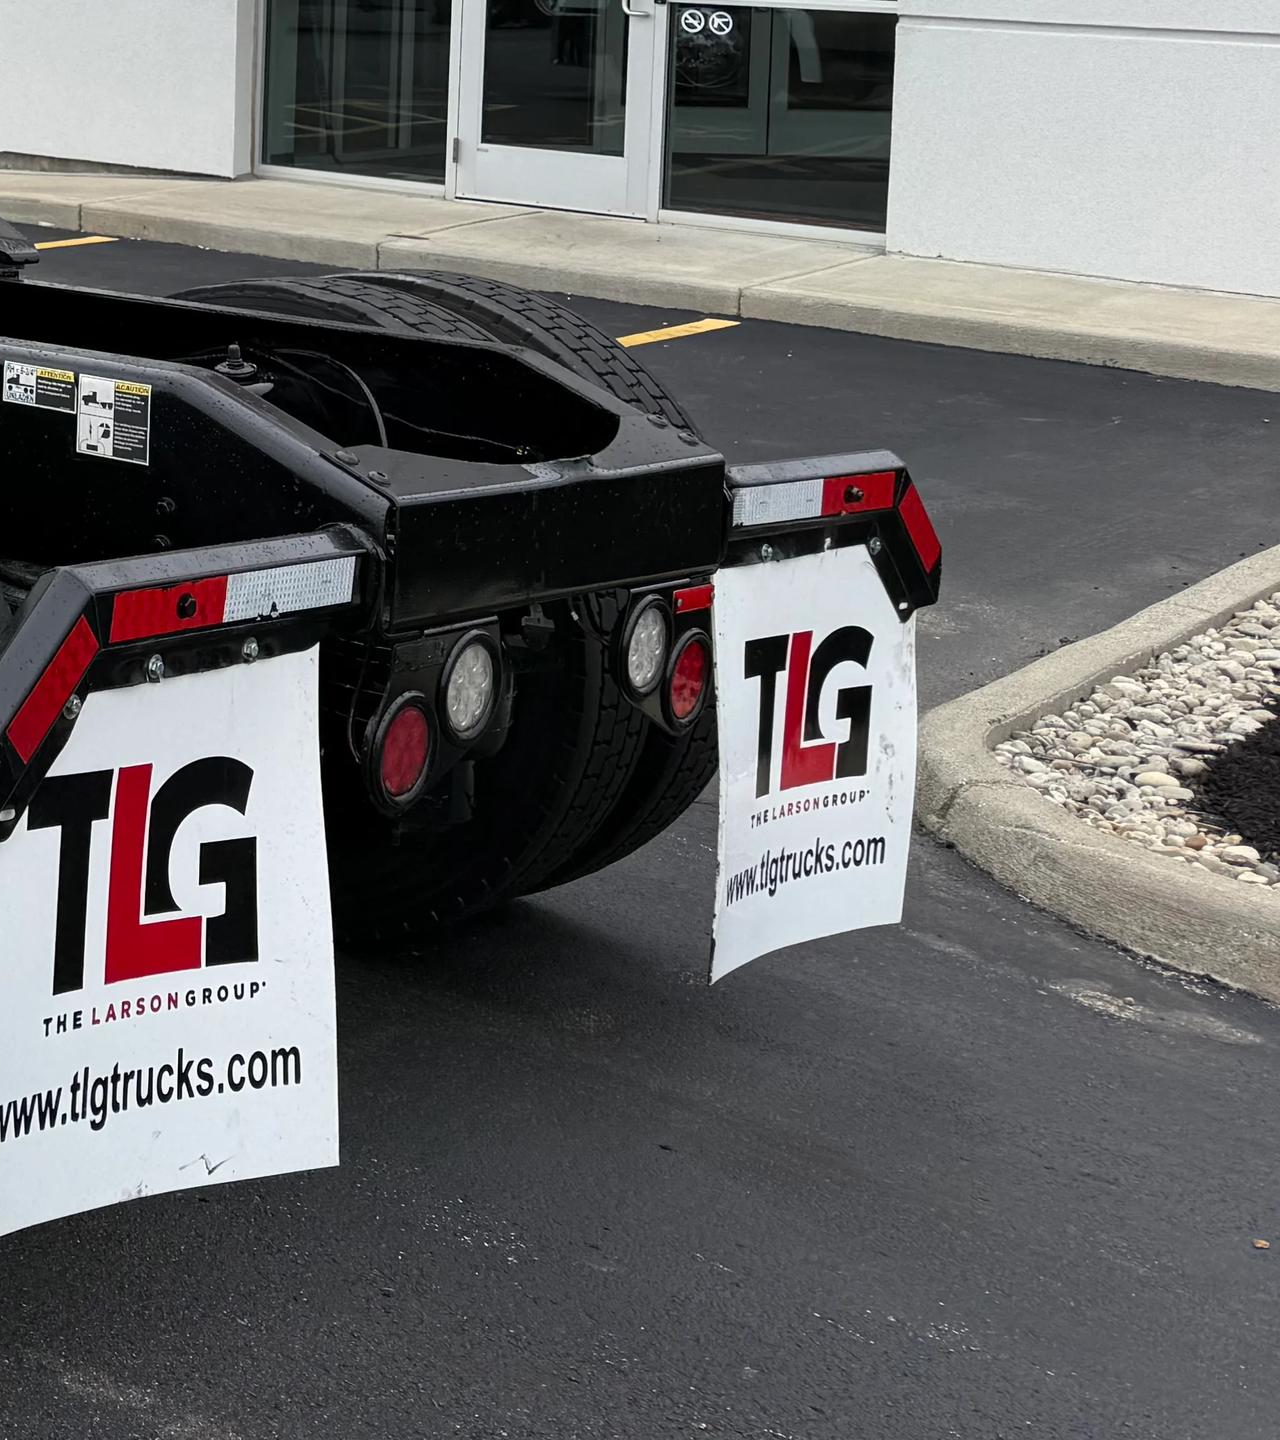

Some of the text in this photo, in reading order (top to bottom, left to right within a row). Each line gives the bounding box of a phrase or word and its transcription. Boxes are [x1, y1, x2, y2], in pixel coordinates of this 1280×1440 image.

[39, 370, 72, 380] ATTENTION
[119, 384, 149, 394] CAUTION
[743, 625, 875, 800] TLG
[751, 809, 769, 829] THE
[26, 756, 259, 996] TLG
[725, 834, 887, 907] www.tlgtrucks.com
[42, 1009, 83, 1038] THE
